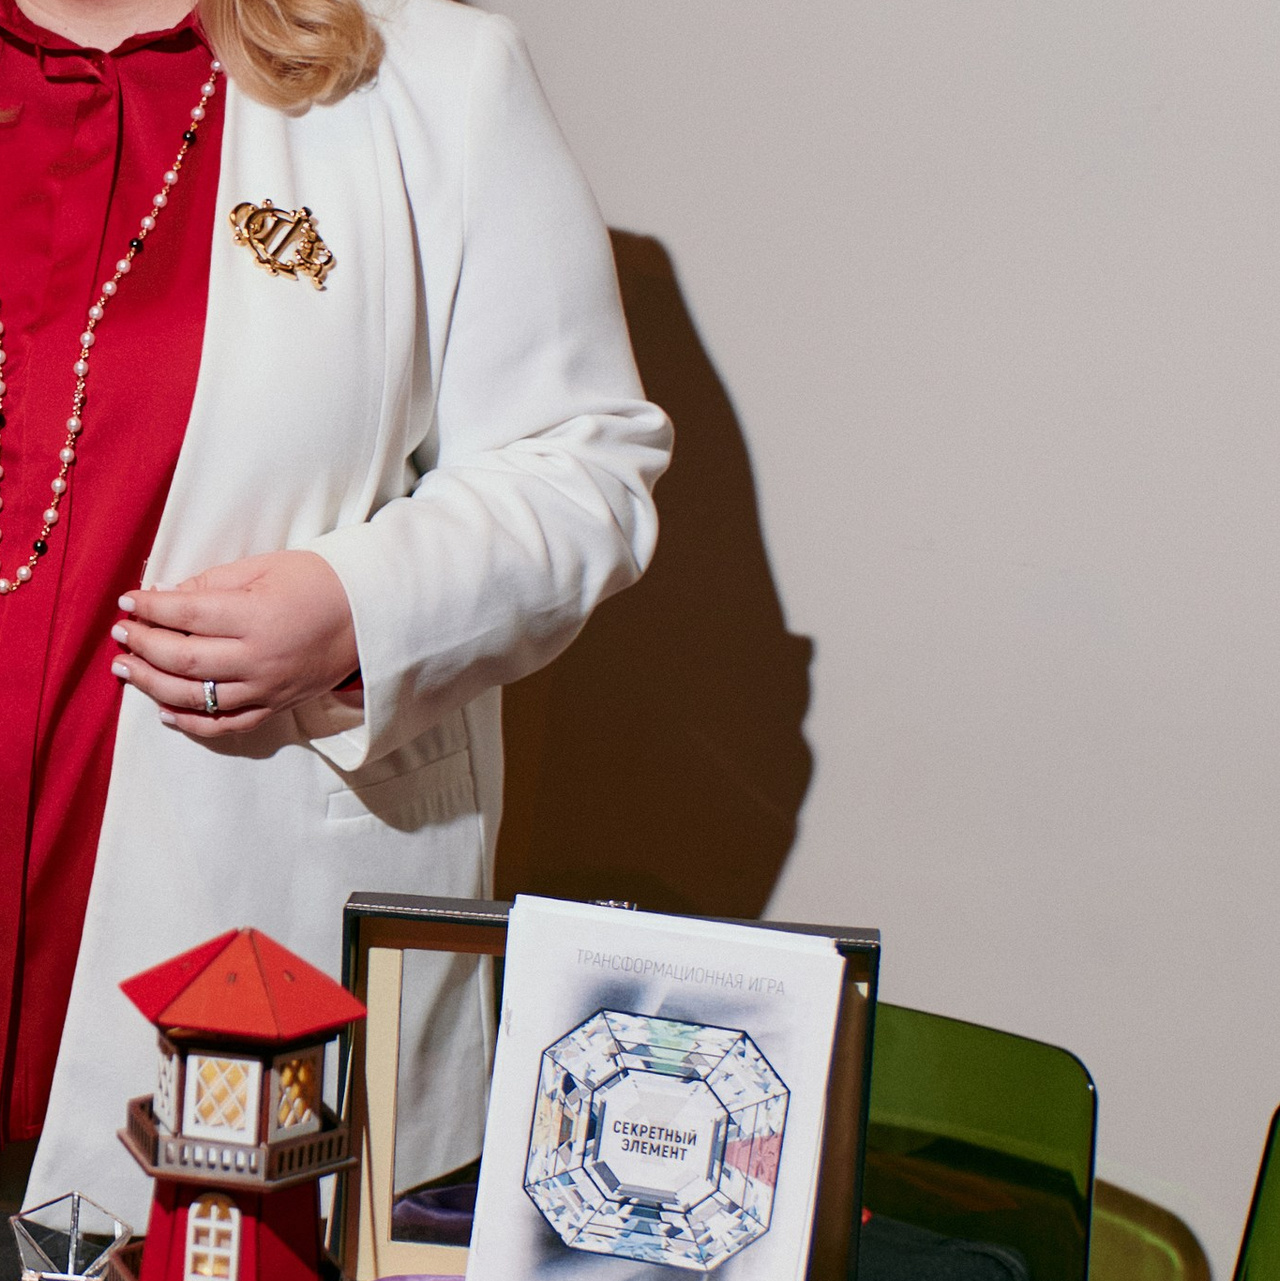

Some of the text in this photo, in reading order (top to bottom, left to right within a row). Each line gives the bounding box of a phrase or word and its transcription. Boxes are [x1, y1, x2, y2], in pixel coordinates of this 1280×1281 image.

[576, 948, 786, 997] ТРАНСФОРМАЦИОННАЯ ИГРА
[612, 1118, 699, 1148] СЕКРЕТНЫЙ
[619, 1139, 690, 1162] ЭЛЕМЕНТ
